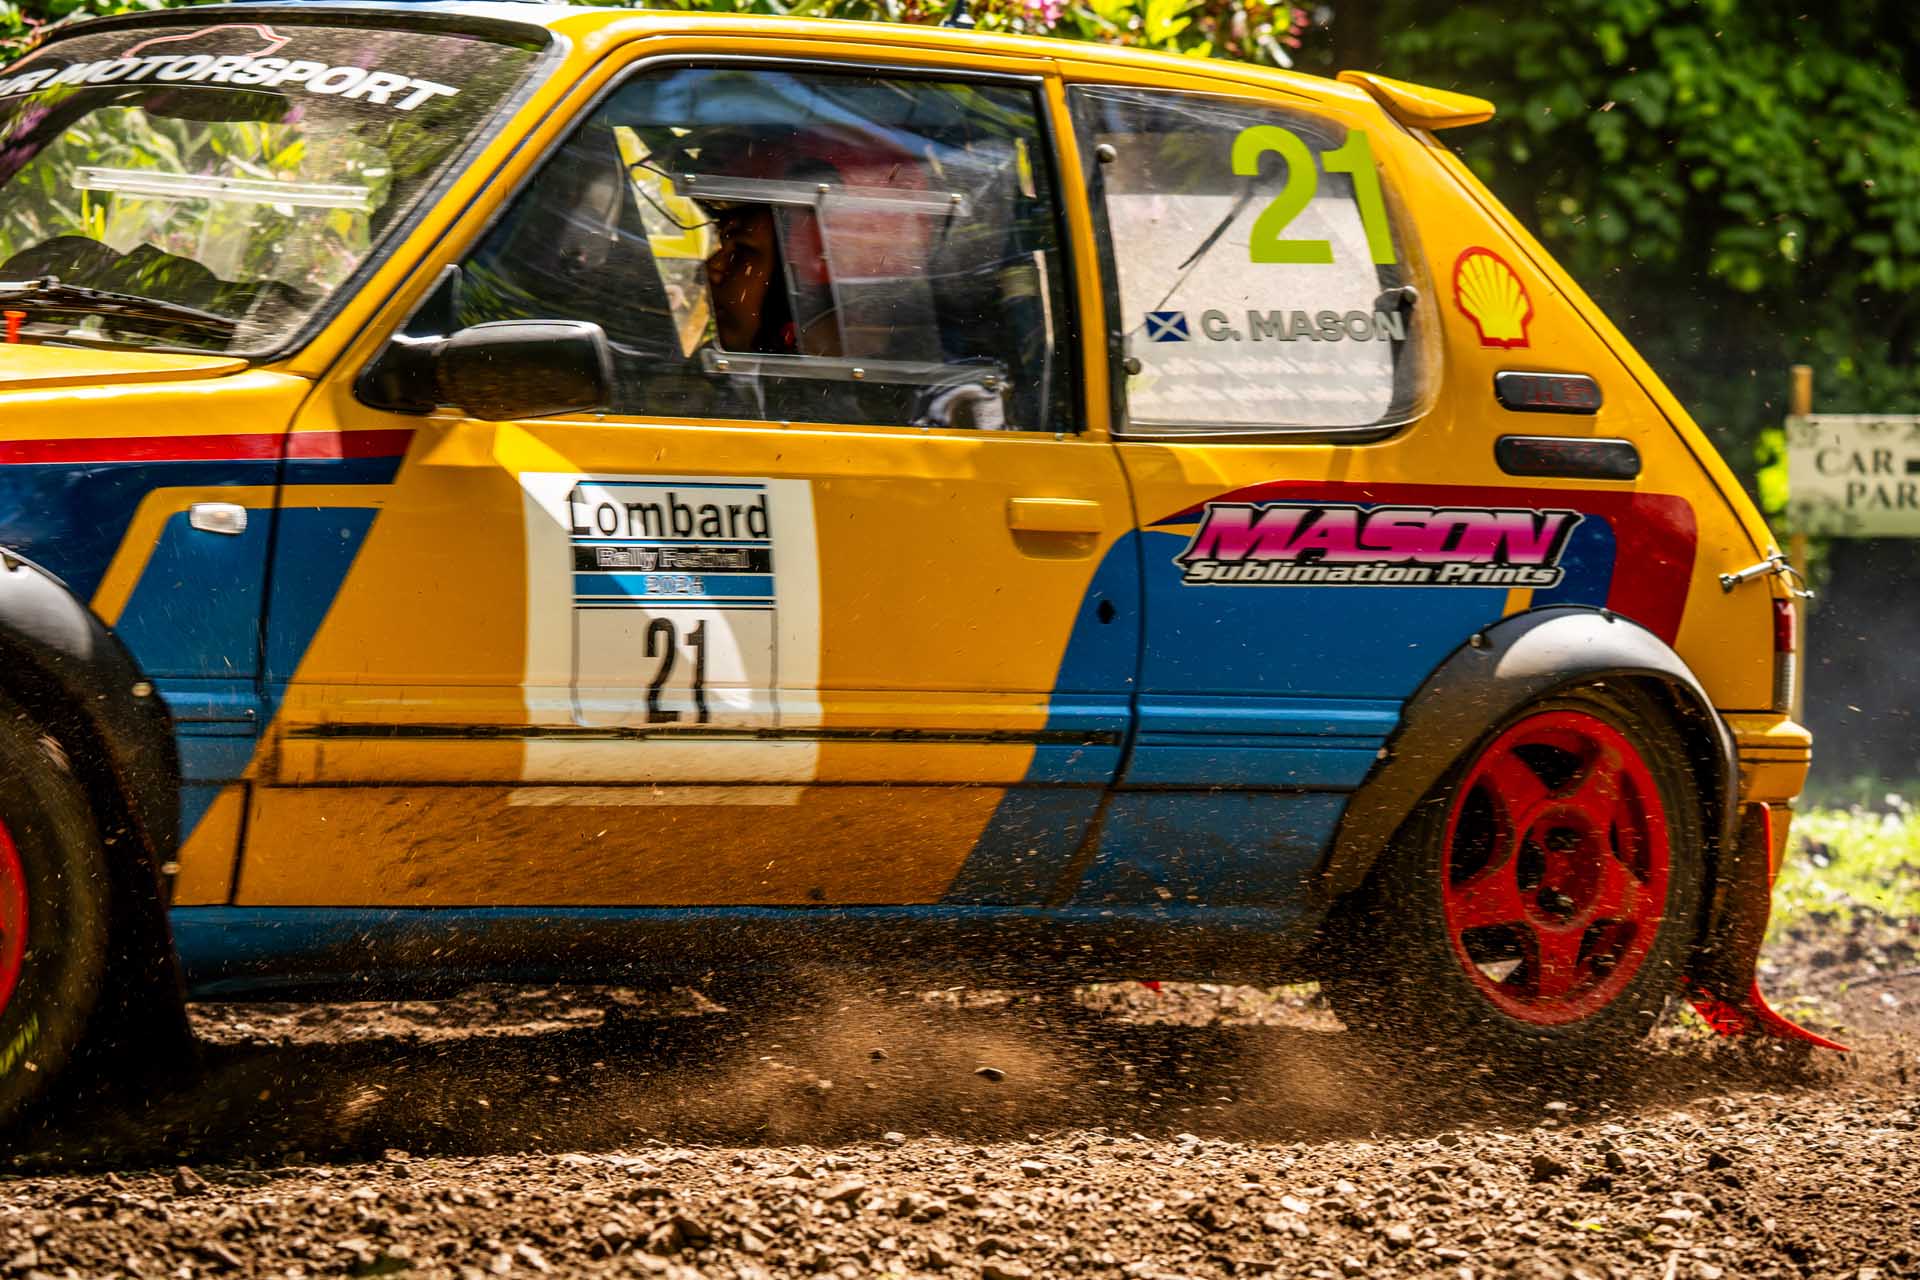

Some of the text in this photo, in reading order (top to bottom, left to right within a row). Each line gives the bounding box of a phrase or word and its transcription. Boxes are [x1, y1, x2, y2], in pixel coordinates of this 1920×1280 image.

[37, 55, 460, 111] MOTORSPORT
[1231, 124, 1397, 265] 21
[1201, 309, 1407, 342] C. MASON
[1815, 449, 1894, 476] CAR
[568, 491, 771, 538] Lombard
[1182, 506, 1569, 565] MASON
[596, 547, 750, 572] Rally Festival
[1184, 560, 1557, 584] Sublimation Prints
[642, 616, 711, 724] 21
